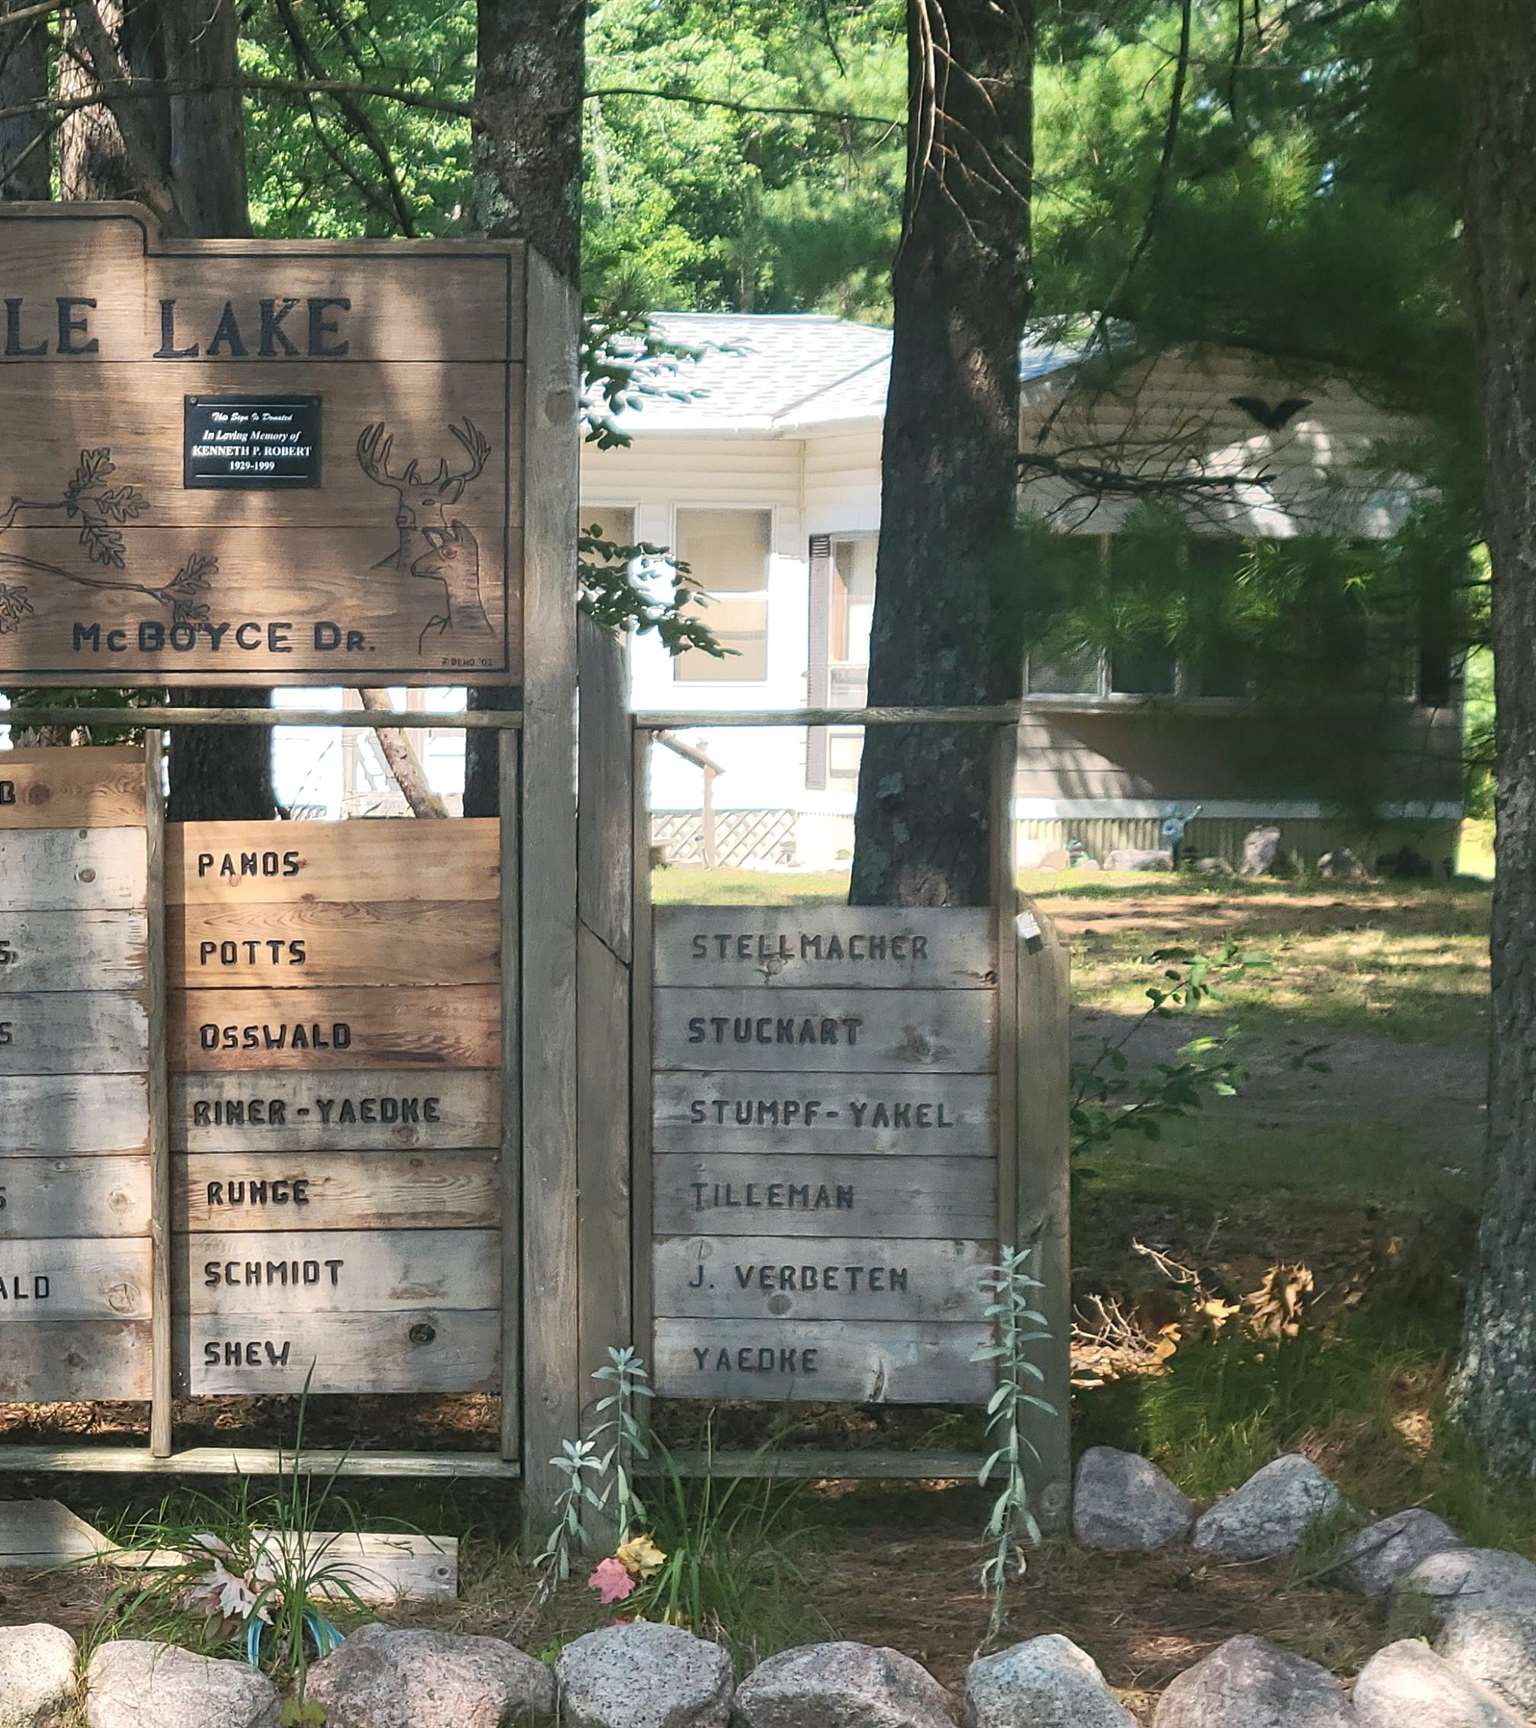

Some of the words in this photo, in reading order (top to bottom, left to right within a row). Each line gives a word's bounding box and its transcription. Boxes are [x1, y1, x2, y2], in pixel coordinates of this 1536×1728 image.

[153, 297, 352, 359] LAKE
[203, 430, 215, 440] In
[216, 430, 248, 442] Loving
[250, 431, 287, 442] Memory
[290, 431, 301, 442] of
[192, 445, 250, 457] KENNETH
[252, 446, 261, 456] P.
[264, 445, 312, 457] ROBERT
[229, 461, 275, 471] 1929-1999
[198, 851, 300, 877] PANOS
[200, 940, 306, 965] POTTS
[692, 934, 929, 960] STELLMACHER
[200, 1023, 352, 1050] OSSWALD
[688, 1017, 863, 1045] STUCKART
[207, 1179, 310, 1206] RUNGE
[691, 1182, 854, 1212] TILLEMAN
[204, 1260, 345, 1286] SCHMIDT
[689, 1264, 714, 1288] J.
[735, 1265, 908, 1292] VERBETEN
[204, 1341, 290, 1367] SHEW
[693, 1347, 818, 1374] YAEDKE
